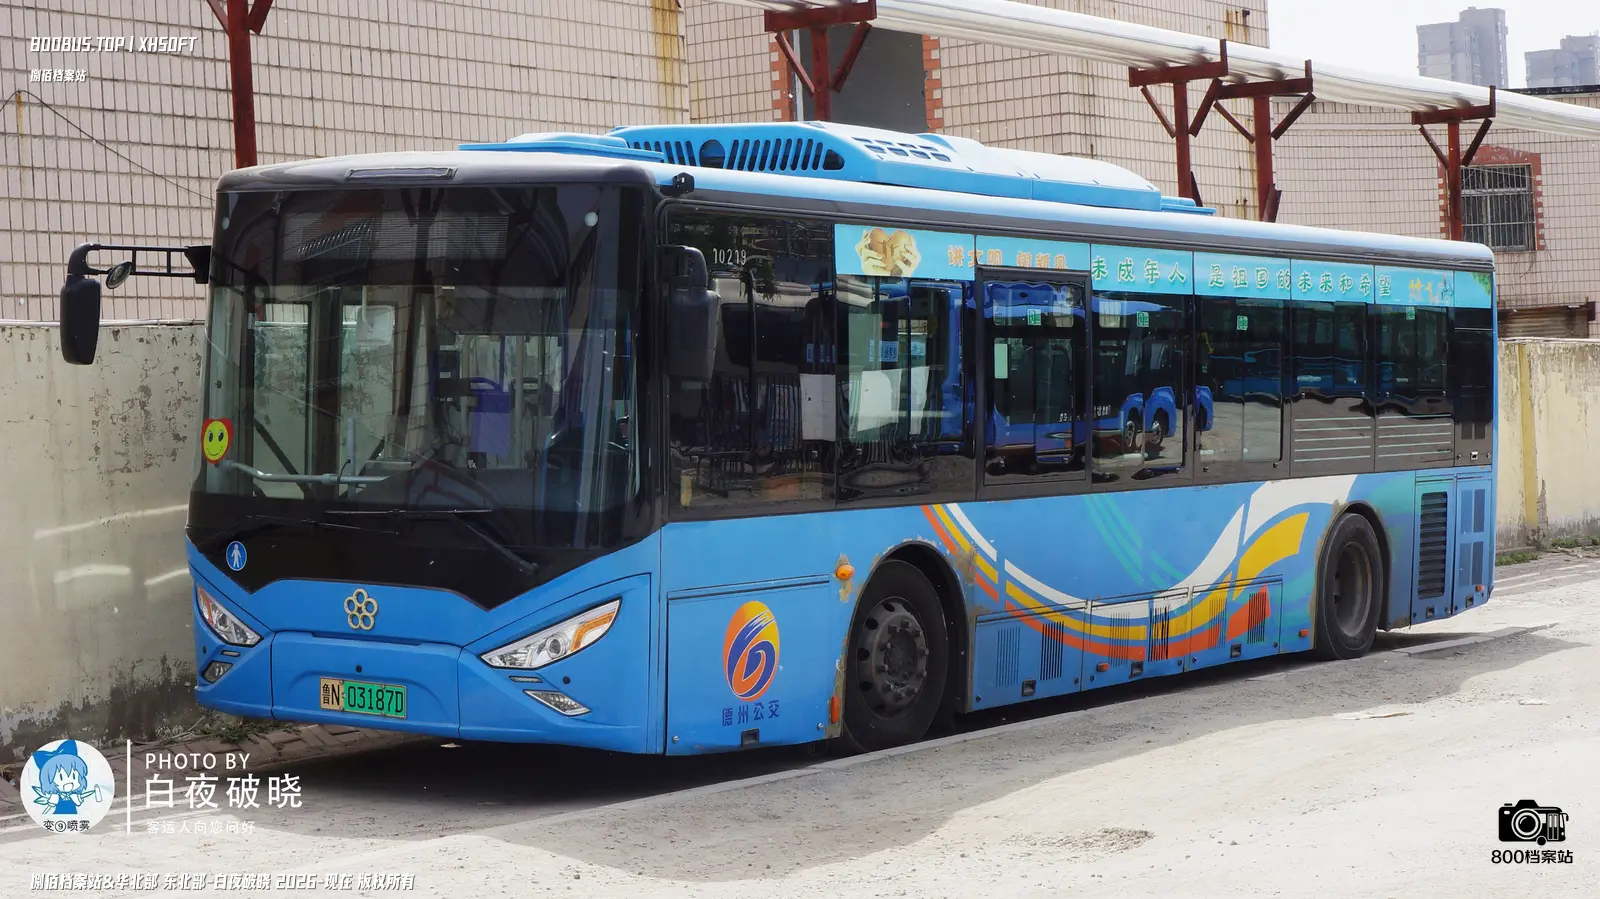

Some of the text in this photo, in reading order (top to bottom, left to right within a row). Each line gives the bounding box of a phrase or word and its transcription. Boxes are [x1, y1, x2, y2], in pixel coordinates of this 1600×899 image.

[713, 248, 747, 265] 10219
[1091, 256, 1187, 284] 未成年人
[1208, 264, 1392, 297] 是祖国的未来和希望
[322, 683, 404, 713] 鲁N 03187D
[722, 700, 779, 727] 德州公交
